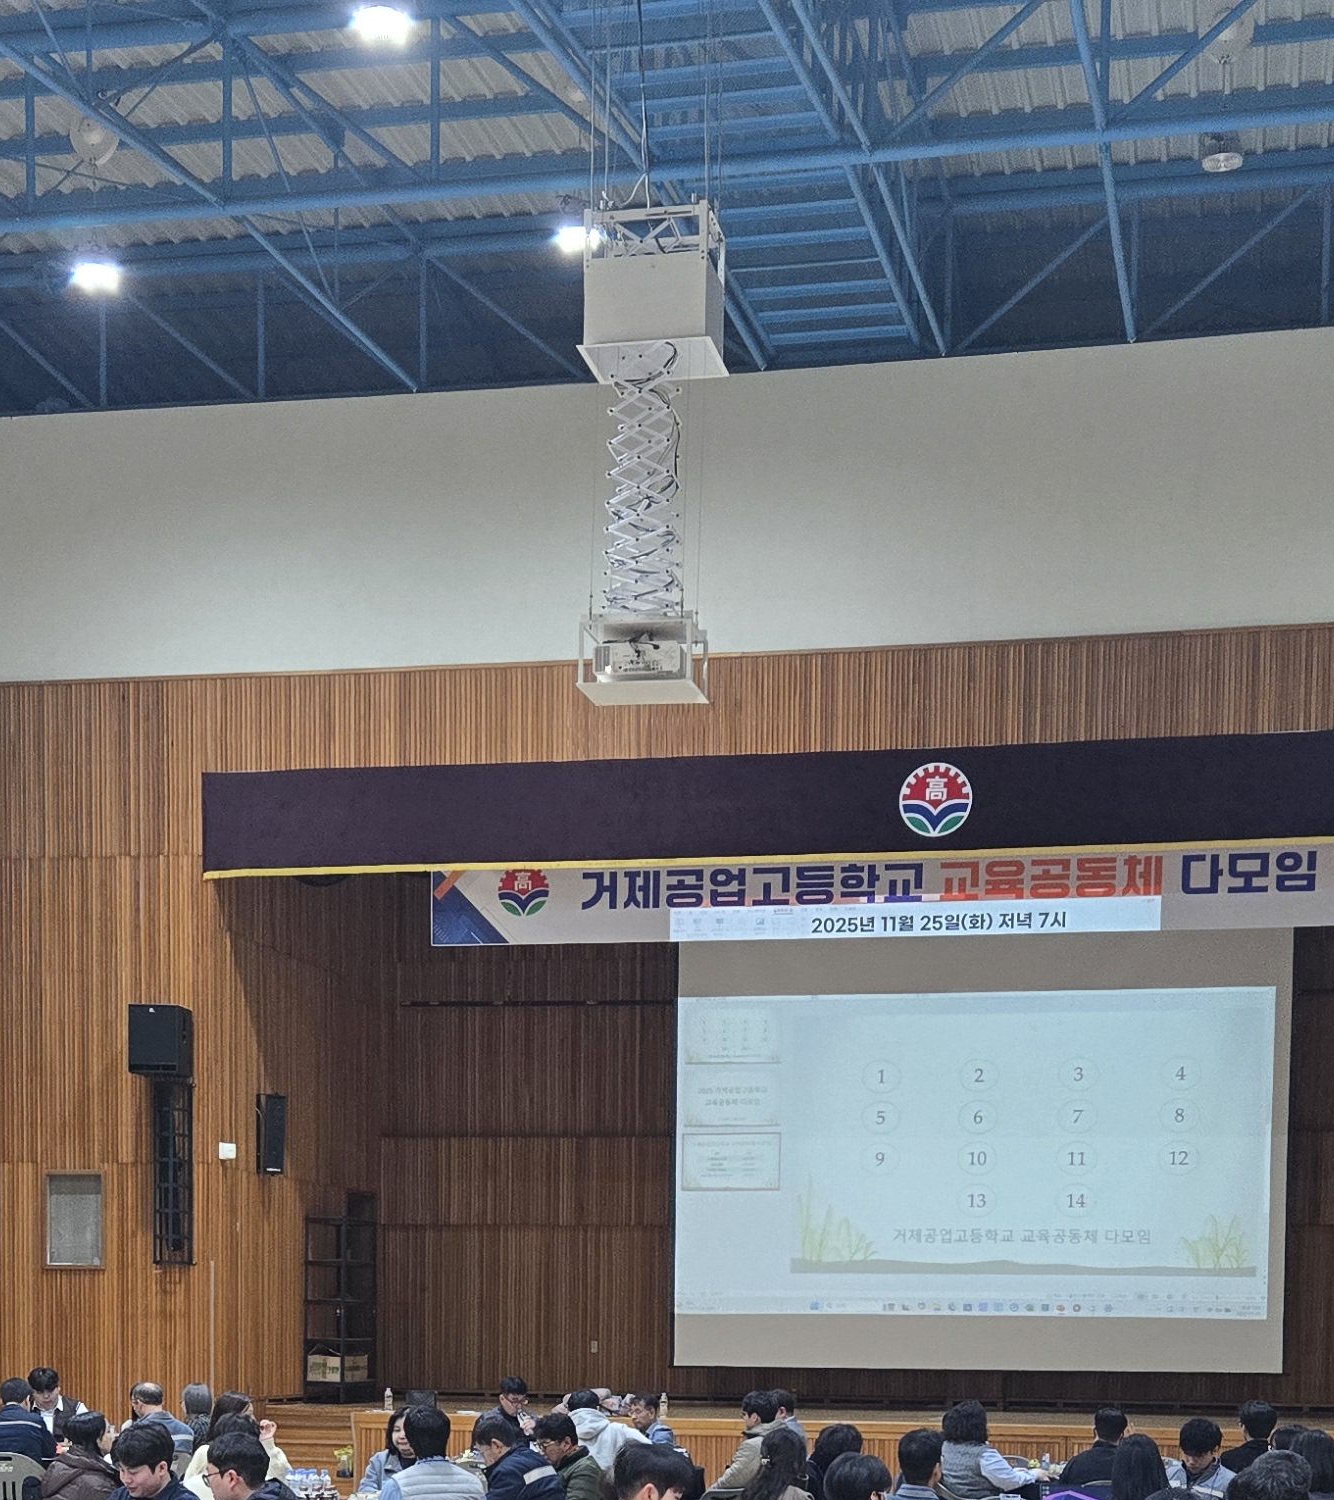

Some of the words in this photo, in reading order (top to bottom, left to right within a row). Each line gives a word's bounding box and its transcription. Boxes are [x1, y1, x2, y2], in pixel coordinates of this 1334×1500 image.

[581, 863, 923, 910] 거제공업고등학교
[939, 855, 1164, 901] 교육공동체
[1181, 850, 1317, 895] 다모임
[811, 915, 875, 934] 2025년
[881, 914, 914, 933] 11월
[920, 912, 993, 932] 25일(화)
[999, 912, 1032, 930] 저녁
[1039, 911, 1067, 929] 7시
[876, 1069, 887, 1084] 1
[974, 1068, 985, 1083] 2
[1073, 1067, 1084, 1082] 3
[1175, 1066, 1187, 1081] 4
[875, 1110, 886, 1125] 5
[973, 1110, 984, 1125] 6
[1073, 1109, 1085, 1124] 7
[1174, 1108, 1185, 1123] 8
[875, 1152, 885, 1167] 9
[968, 1151, 987, 1166] 10
[1067, 1151, 1086, 1166] 11
[1168, 1150, 1190, 1166] 12
[967, 1193, 987, 1209] 13
[1066, 1193, 1086, 1209] 14
[892, 1227, 1015, 1245] 거제공업고등학교
[1020, 1227, 1098, 1245] 교육공동체
[1104, 1228, 1153, 1246] 다모임
